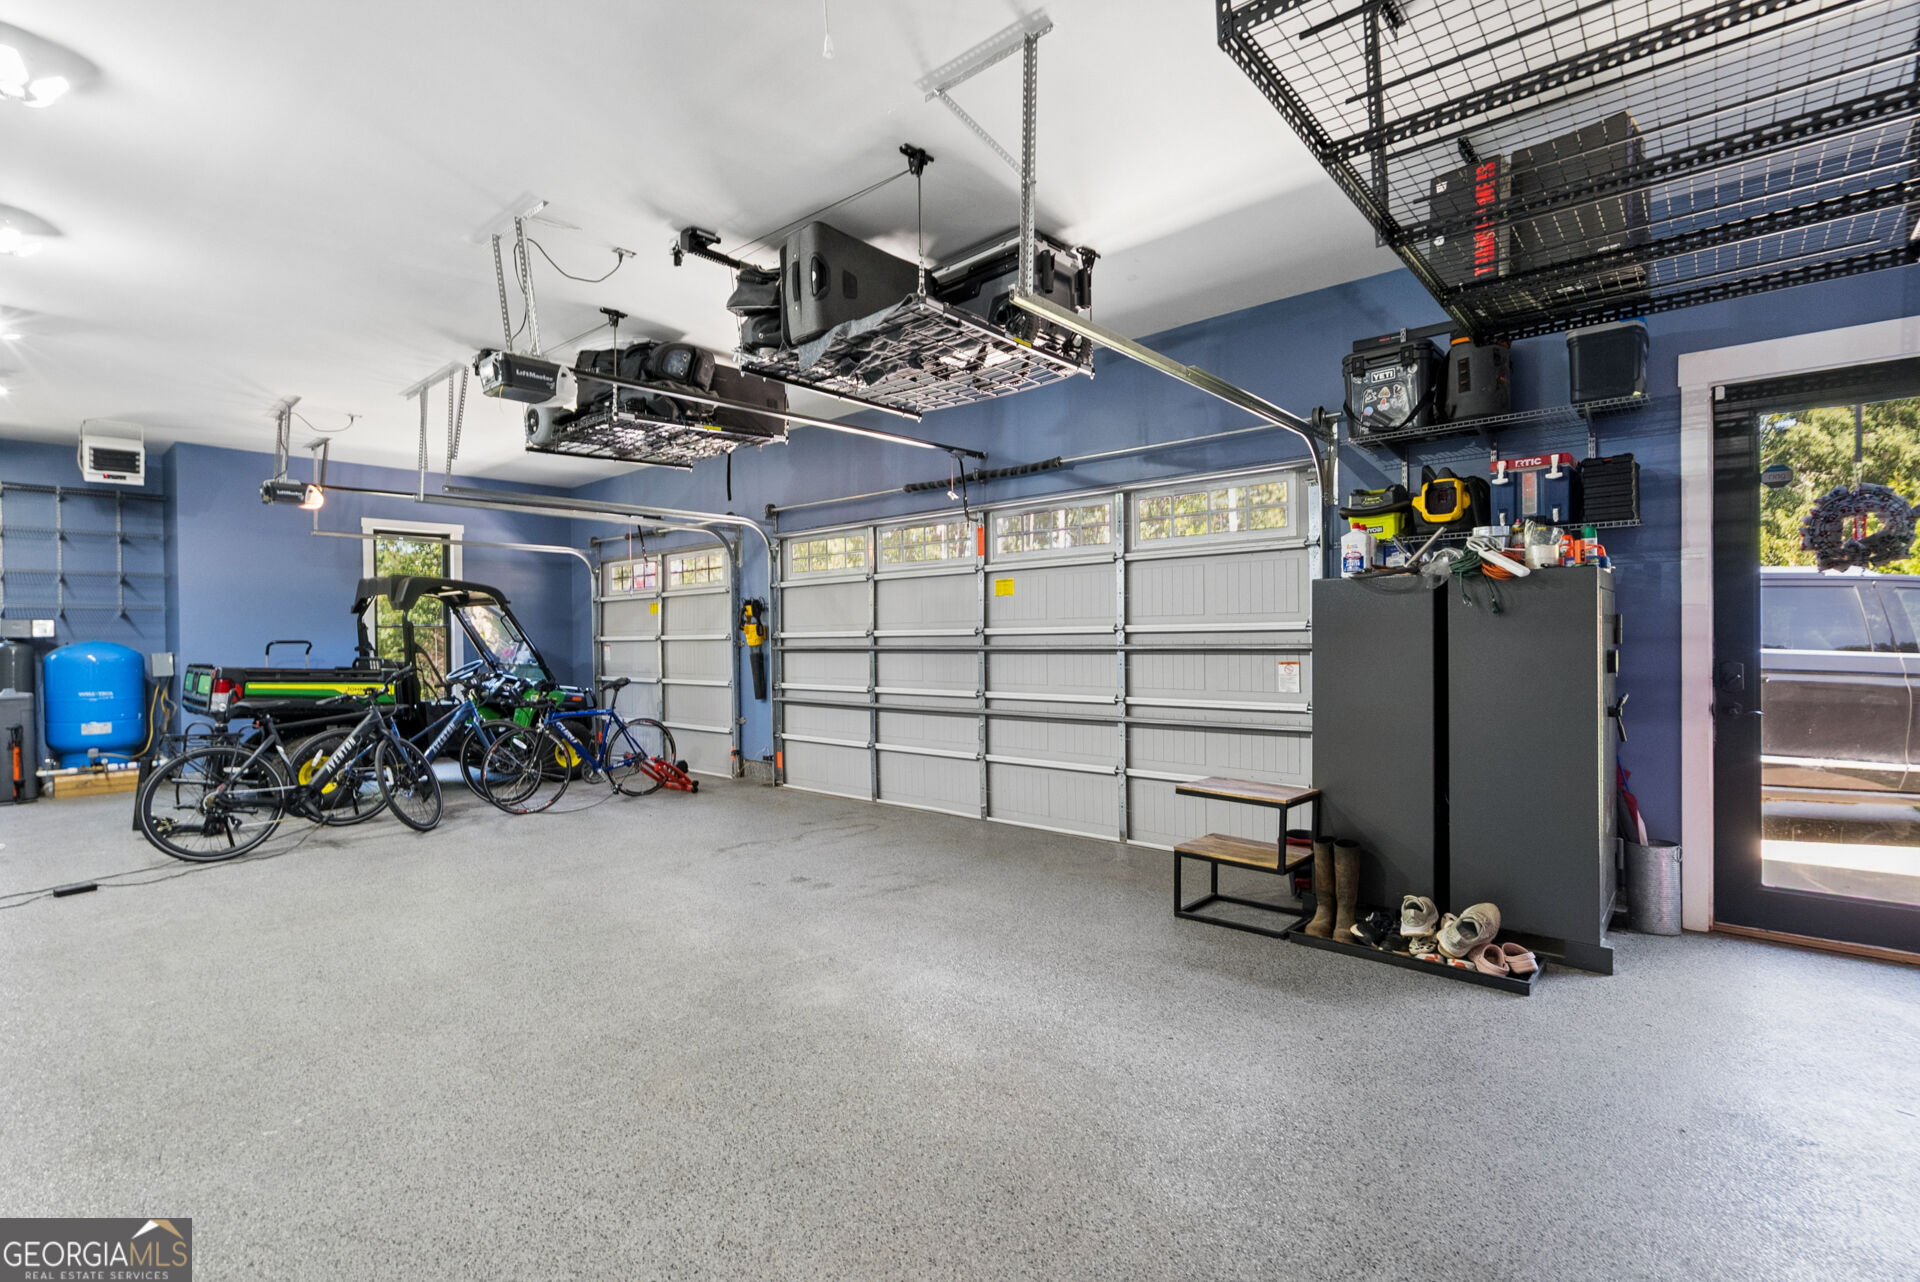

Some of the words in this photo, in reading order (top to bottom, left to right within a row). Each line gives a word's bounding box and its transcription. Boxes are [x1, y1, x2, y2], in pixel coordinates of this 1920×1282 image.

[1474, 161, 1496, 278] TRANSFRMERS
[515, 368, 553, 382] LiftMaster
[1372, 370, 1393, 381] YETI
[1514, 457, 1542, 468] RTIC
[325, 735, 357, 774] AVENTON
